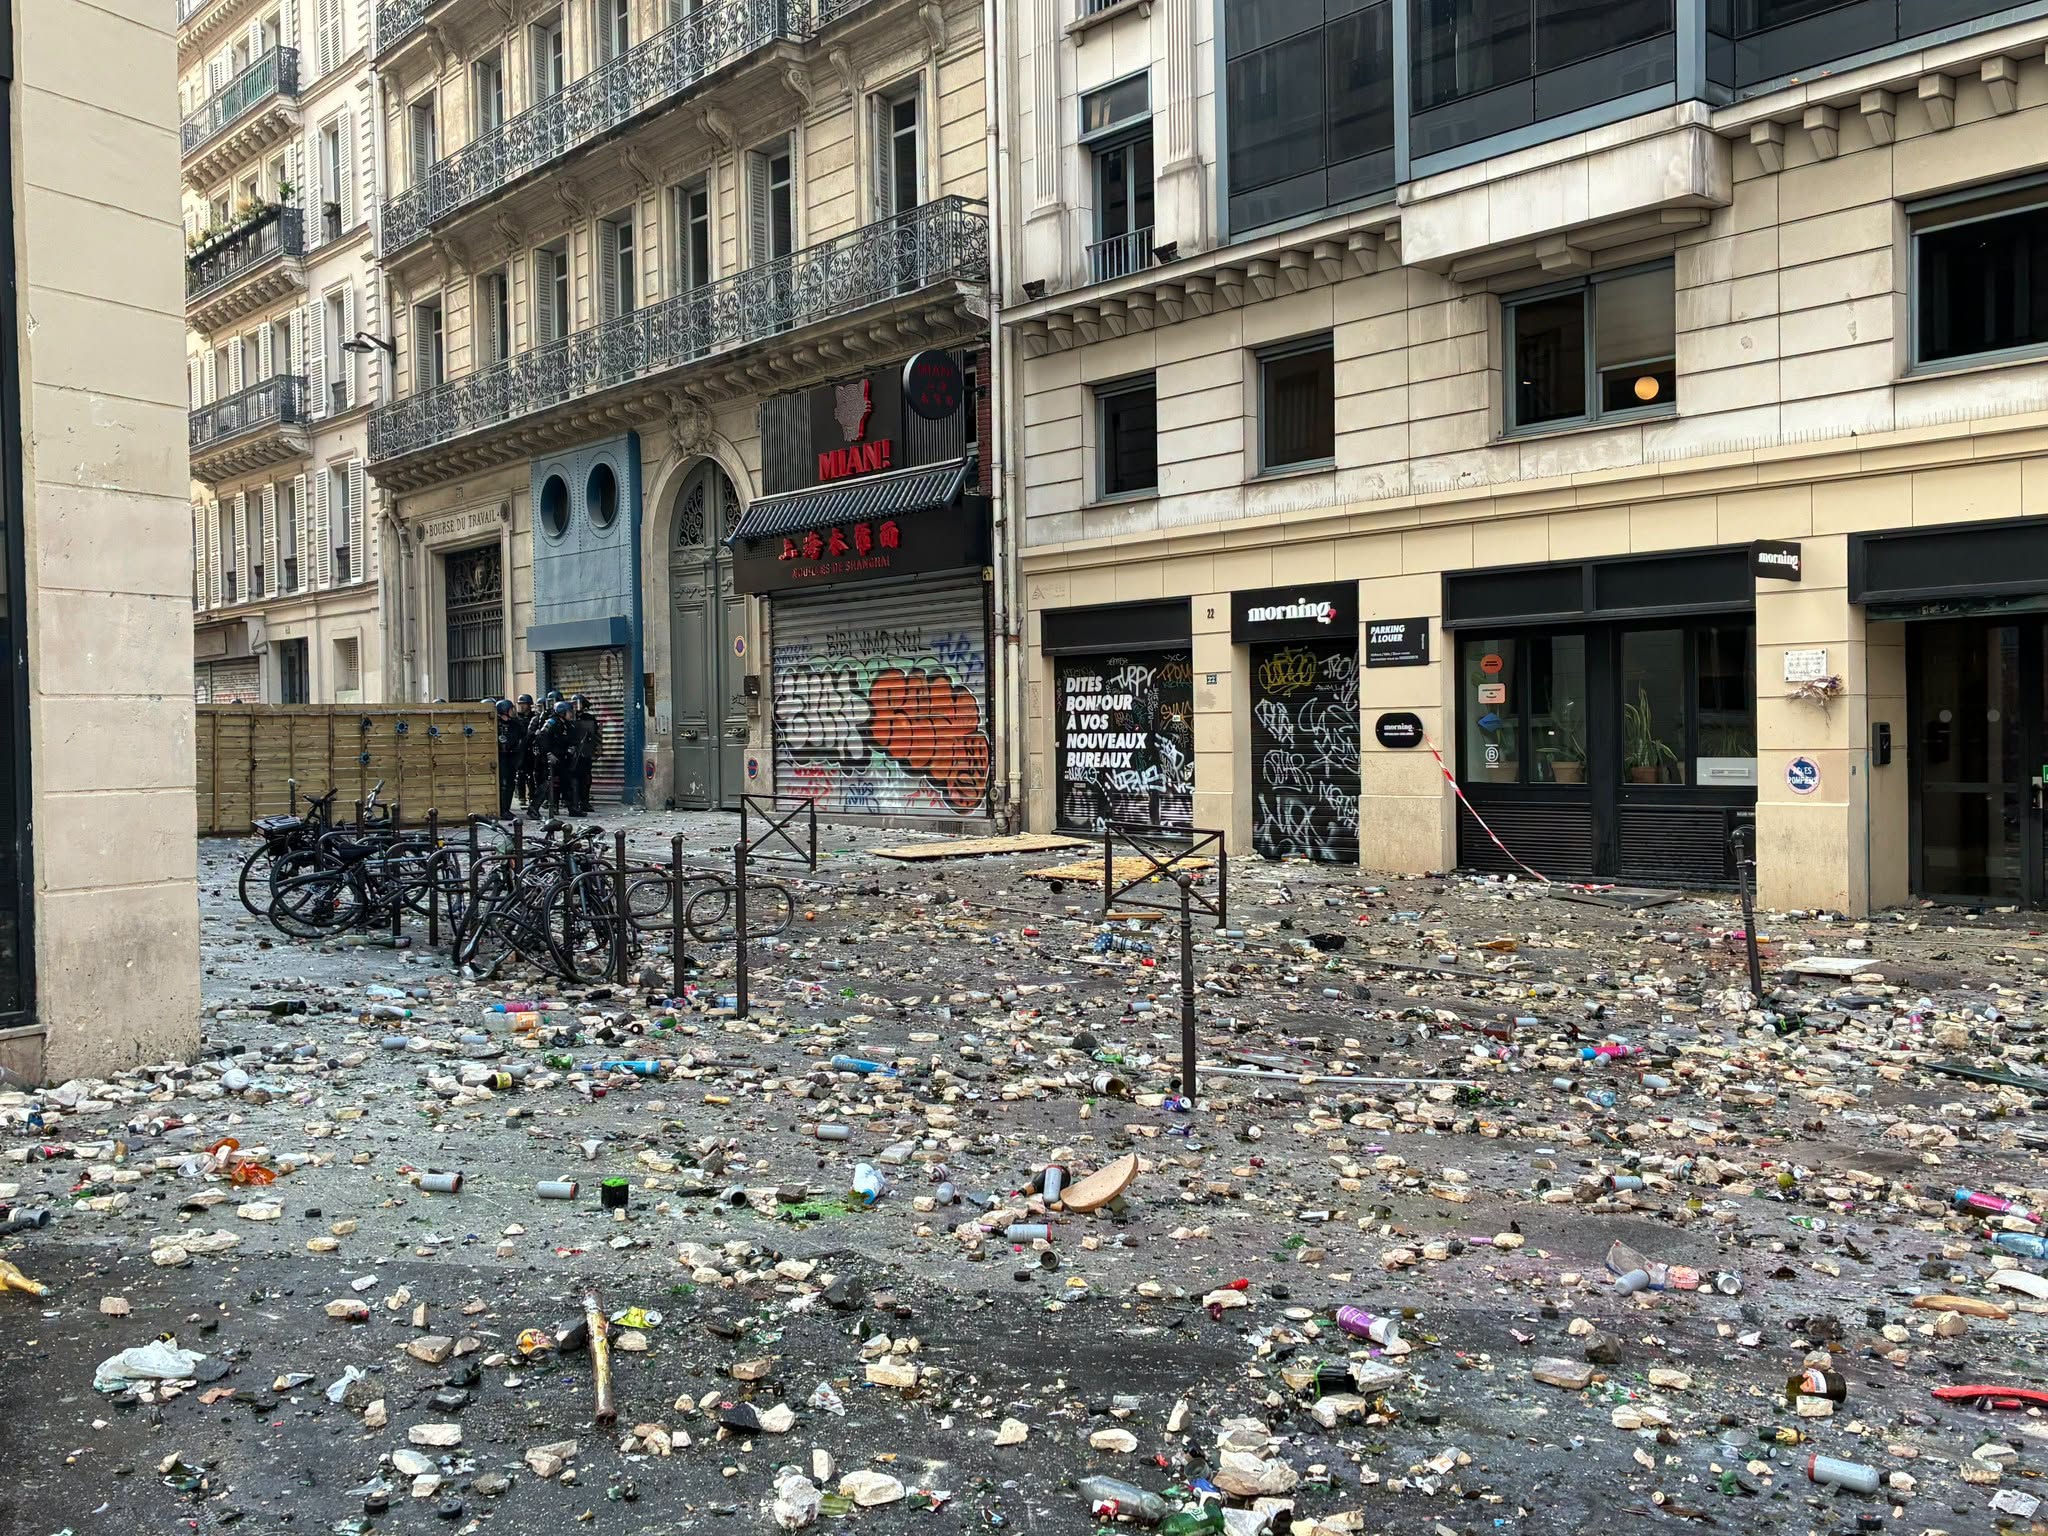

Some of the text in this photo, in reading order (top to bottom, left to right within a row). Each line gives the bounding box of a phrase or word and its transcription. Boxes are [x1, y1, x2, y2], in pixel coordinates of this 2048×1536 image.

[818, 439, 892, 481] MIAN!
[429, 509, 497, 537] BOURSE DU TRAVAIL
[1207, 608, 1215, 619] 22
[1370, 624, 1406, 635] PARKING
[1378, 633, 1404, 643] LOUER
[1065, 676, 1103, 693] DITES
[1065, 694, 1133, 712] BONJOUR
[1066, 710, 1077, 731] À
[1080, 714, 1109, 731] VOS
[1066, 732, 1148, 750] NOUVEAUX
[1066, 751, 1134, 769] BUREAUX
